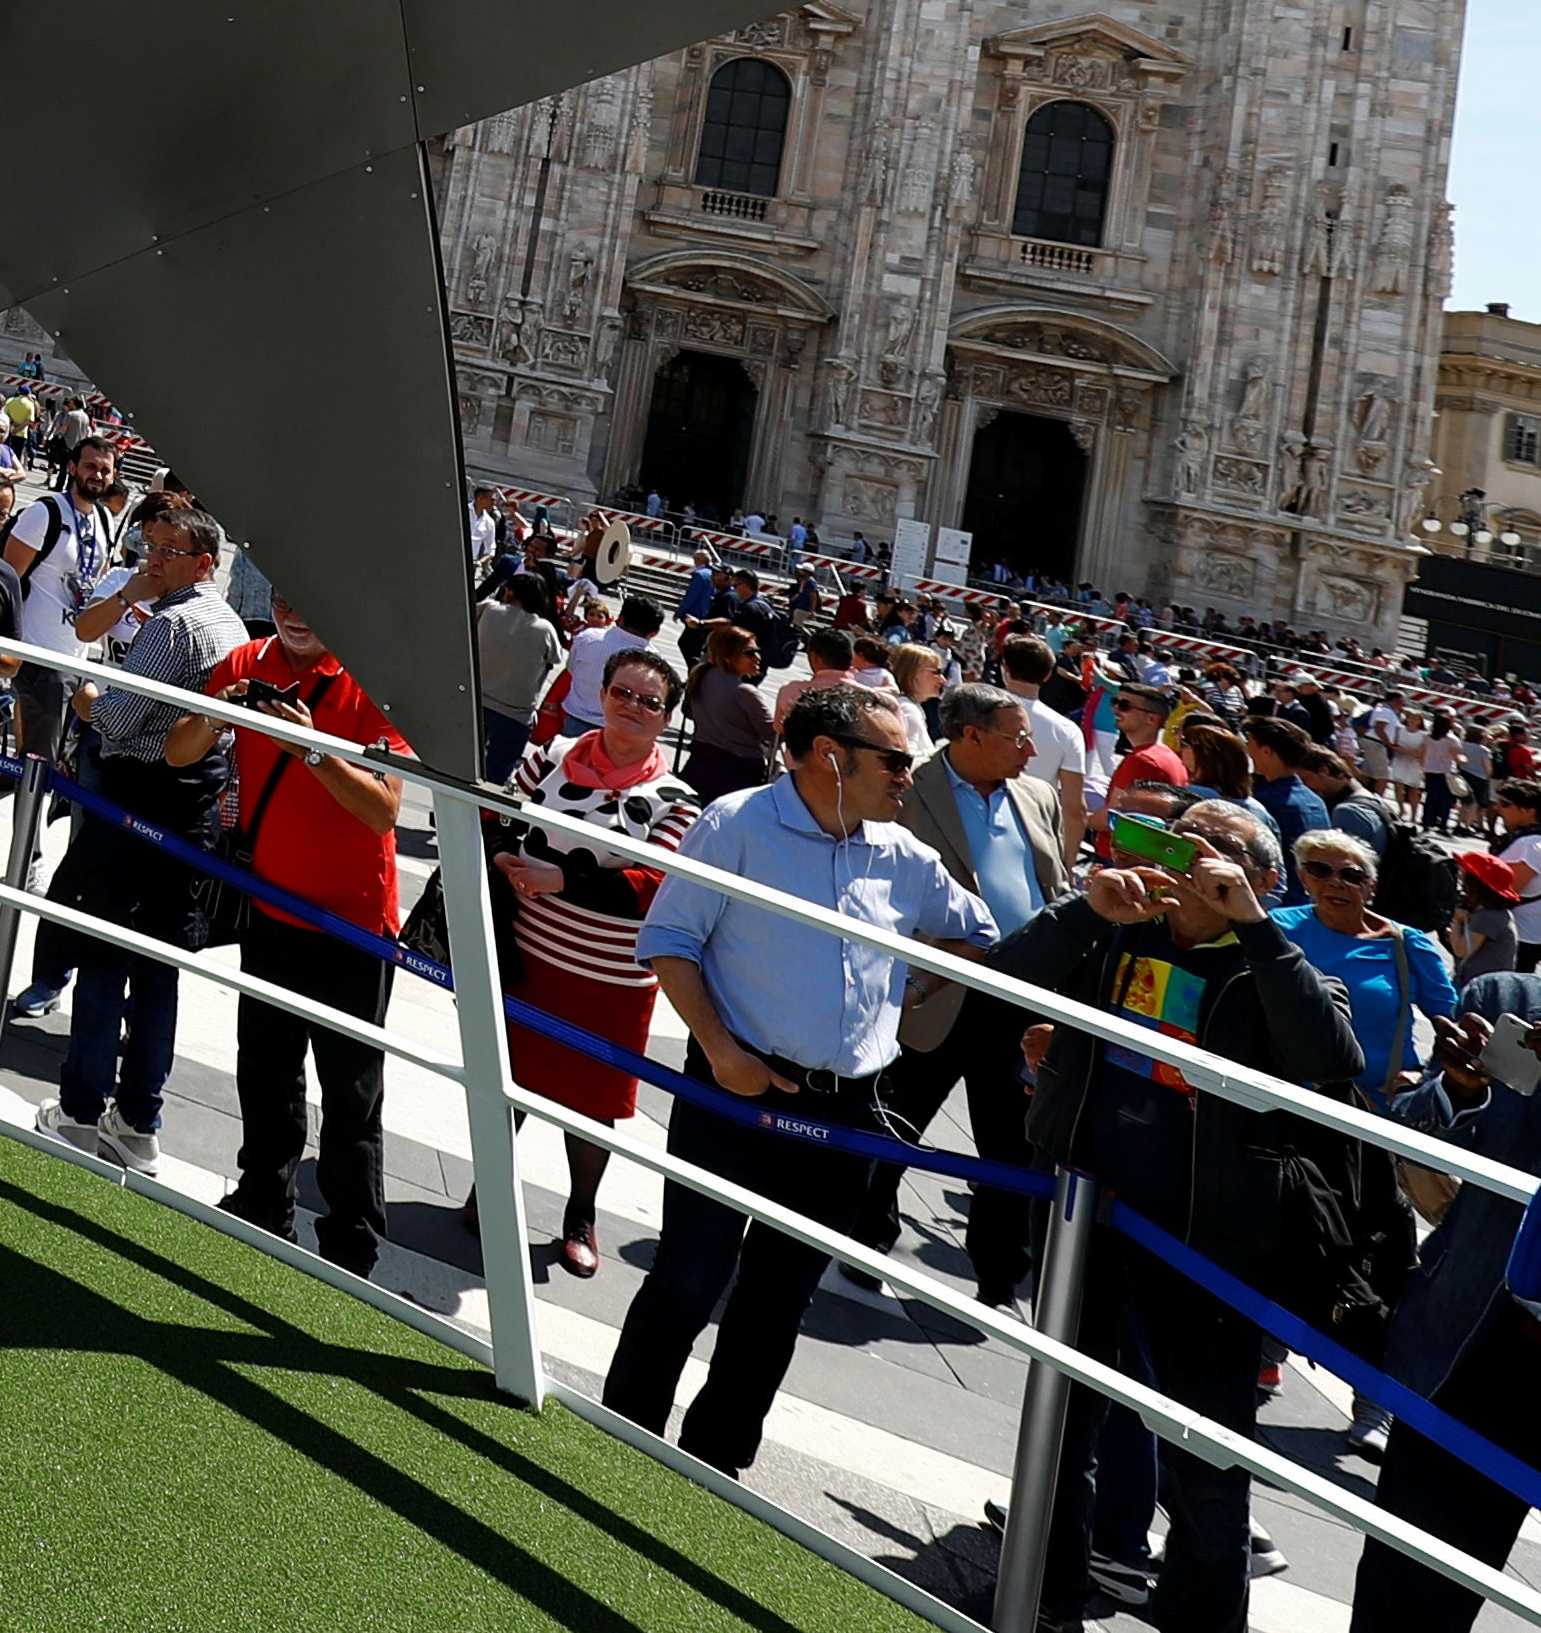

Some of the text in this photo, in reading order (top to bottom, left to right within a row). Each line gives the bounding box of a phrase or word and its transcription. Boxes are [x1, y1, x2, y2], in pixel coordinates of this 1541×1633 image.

[132, 819, 164, 842] RESPECT
[405, 956, 448, 981] RESPECT
[776, 1118, 830, 1140] RESPECT
